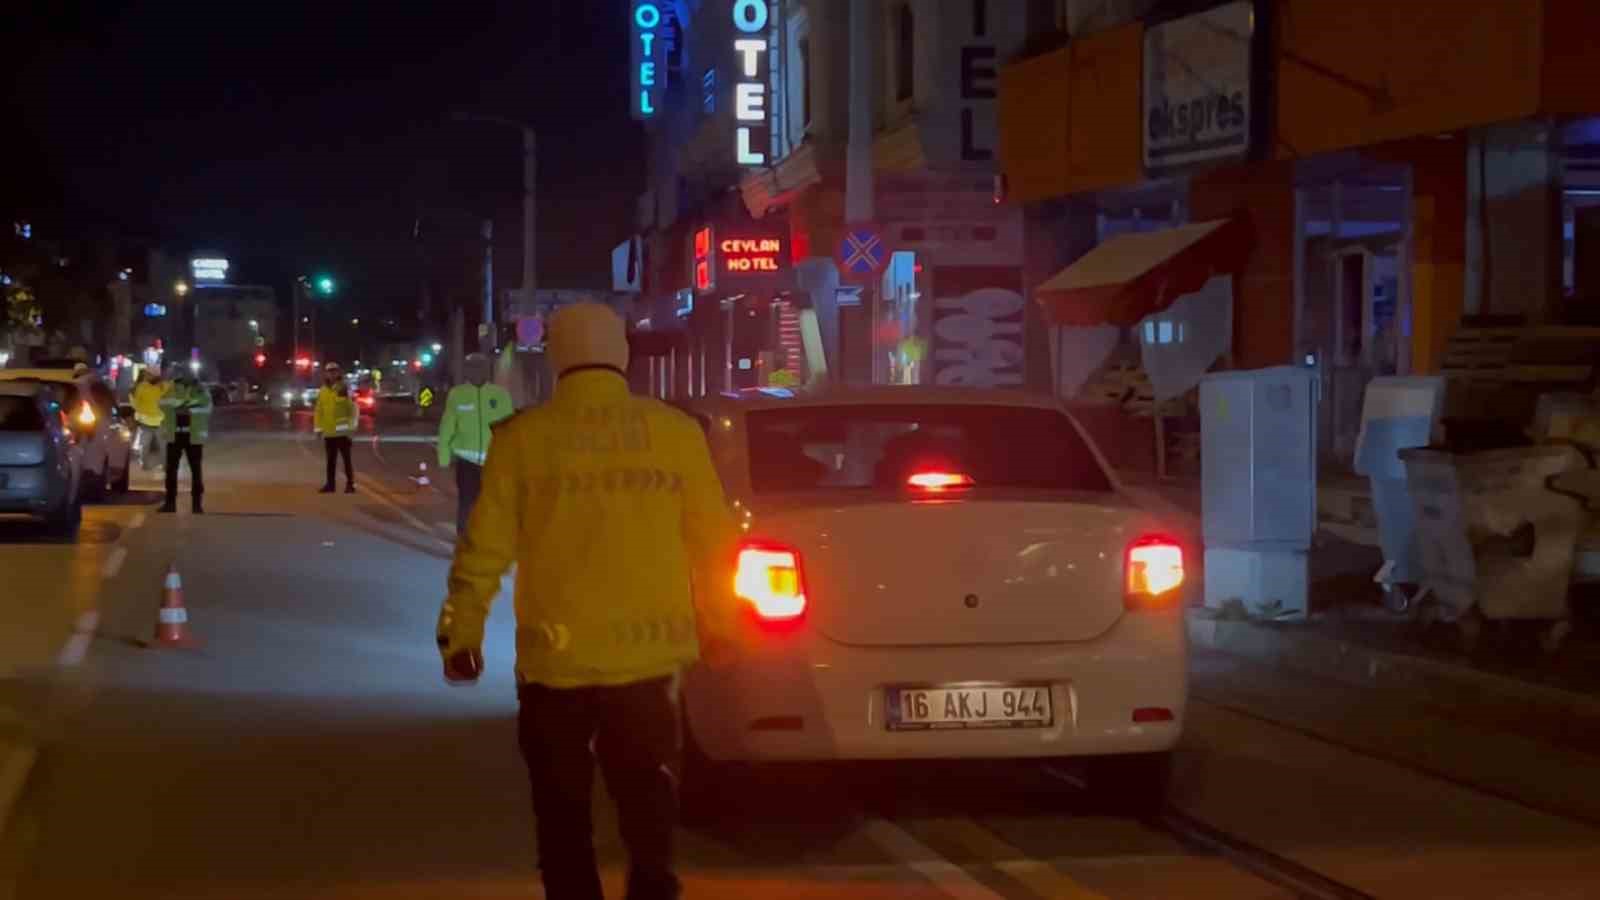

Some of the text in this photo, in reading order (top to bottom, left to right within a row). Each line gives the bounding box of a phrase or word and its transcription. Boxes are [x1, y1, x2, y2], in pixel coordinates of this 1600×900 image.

[635, 4, 660, 114] OTEL
[733, 0, 768, 164] OTEL
[721, 239, 780, 253] CEYLAN
[904, 690, 1044, 718] 16 AKJ 944
